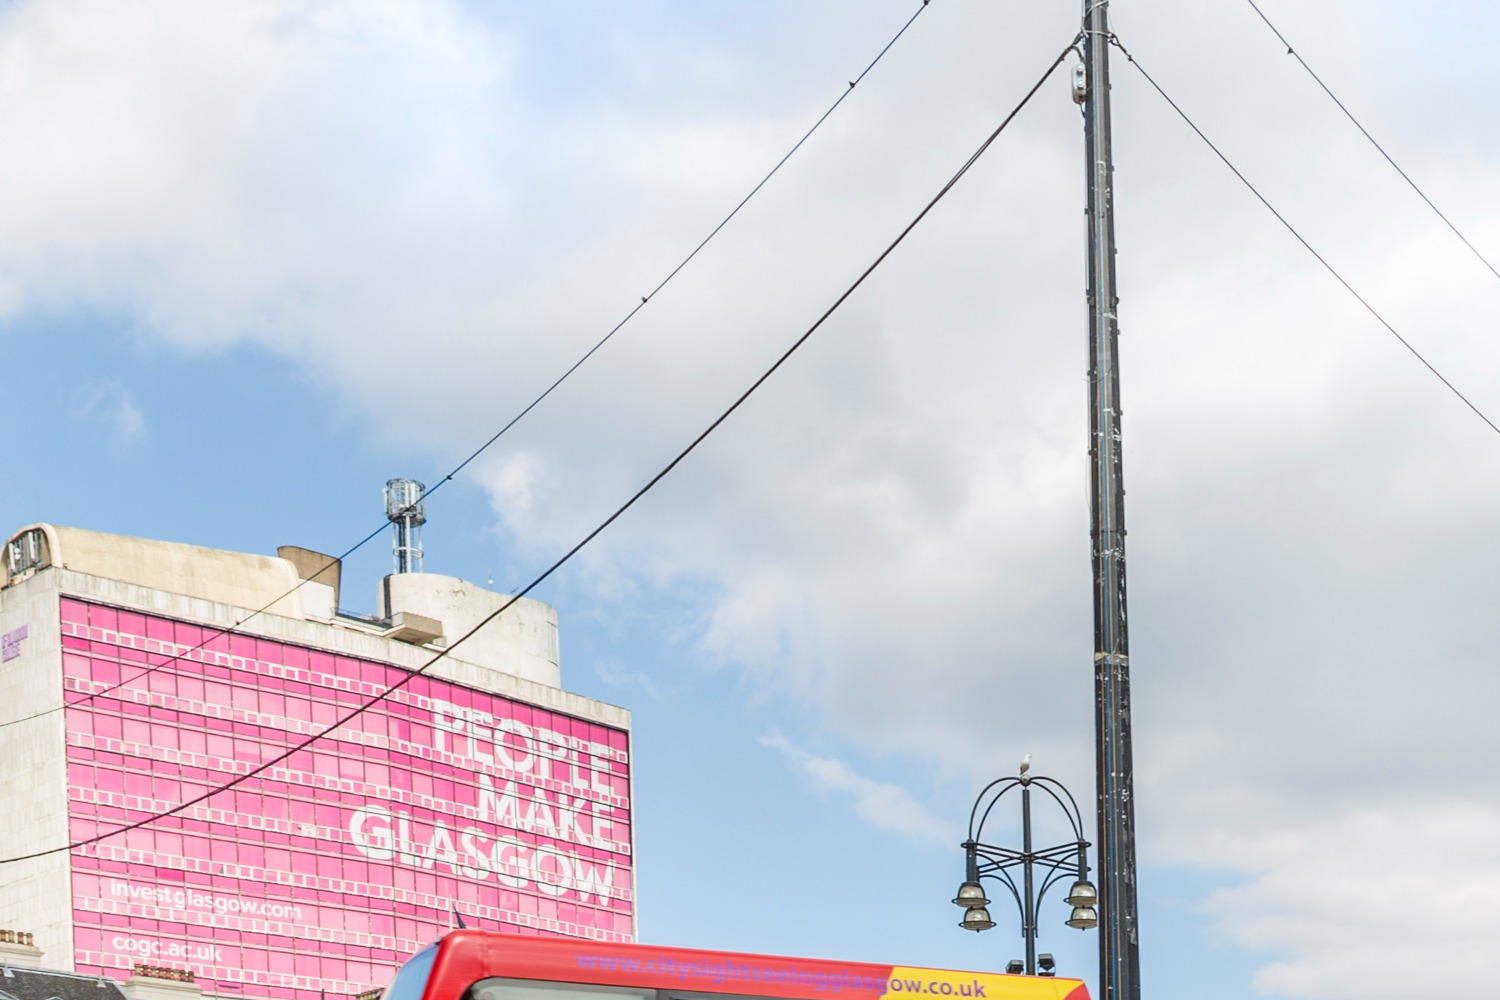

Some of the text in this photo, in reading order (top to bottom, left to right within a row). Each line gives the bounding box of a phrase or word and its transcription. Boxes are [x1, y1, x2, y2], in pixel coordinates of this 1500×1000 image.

[433, 699, 615, 797] PEOPLE
[478, 774, 616, 850] MAKE
[350, 805, 616, 906] GLASGOW
[112, 935, 223, 962] cogc.ac.uk
[576, 953, 987, 998] www.citysightseeingglasgow.co.uk
